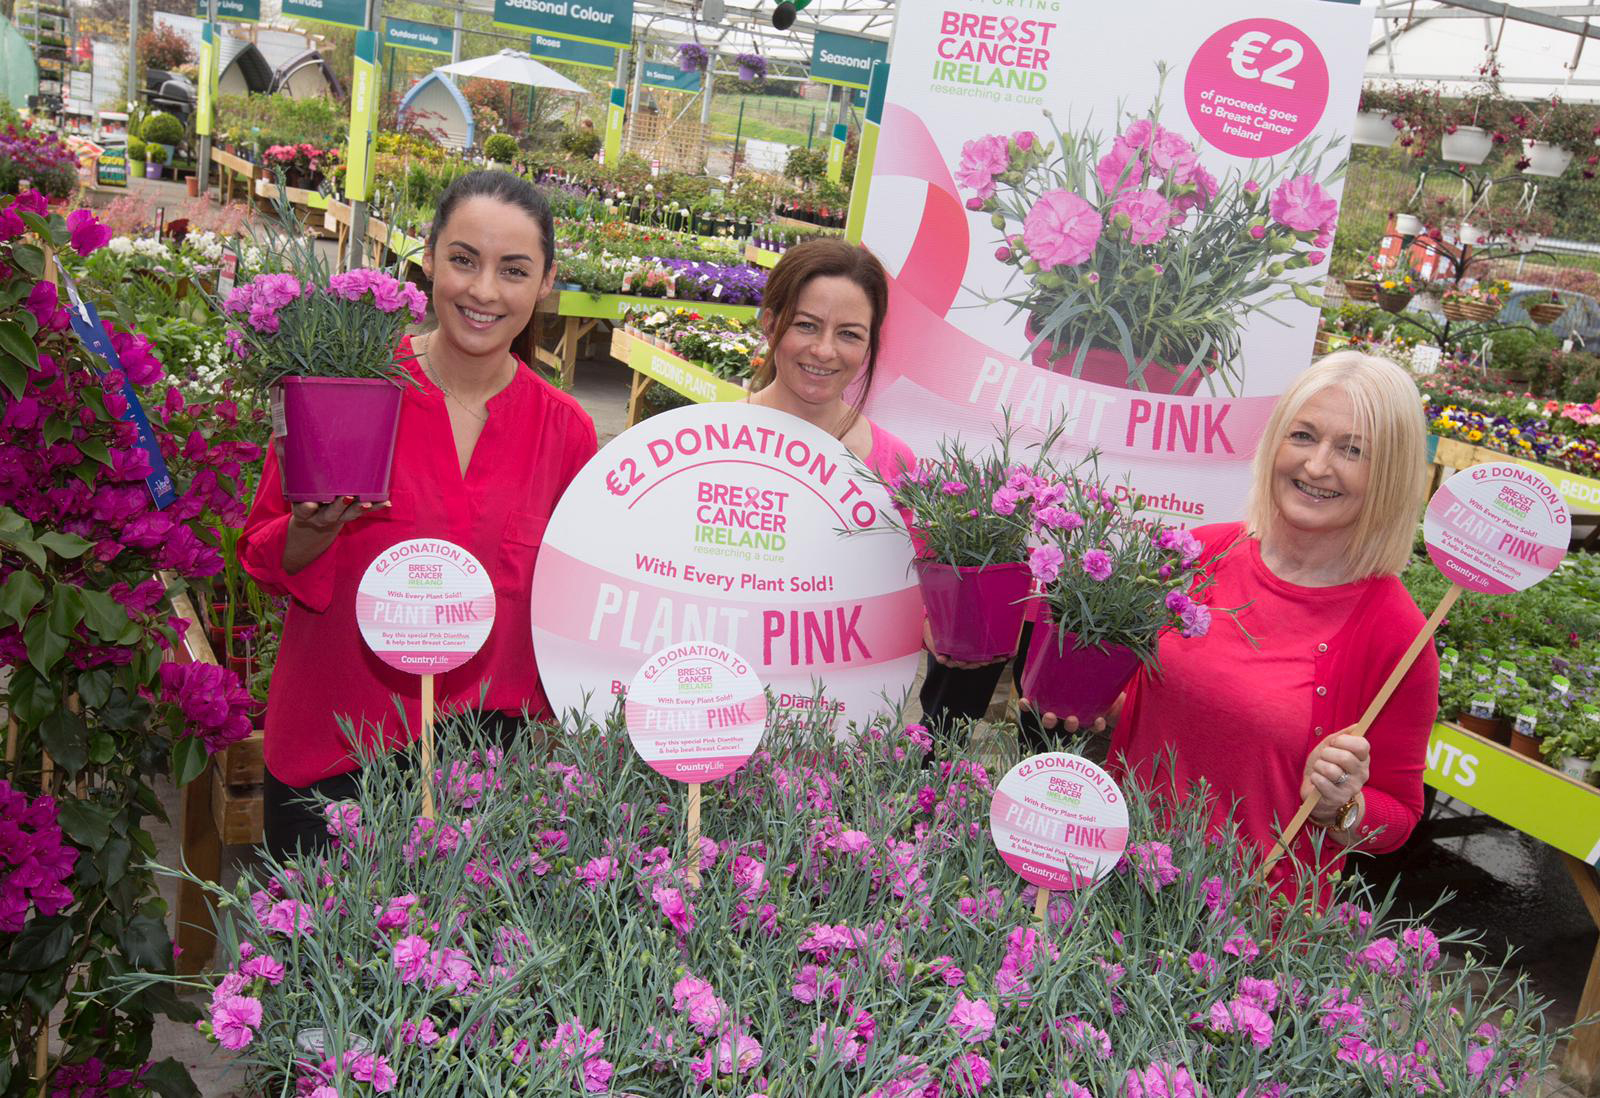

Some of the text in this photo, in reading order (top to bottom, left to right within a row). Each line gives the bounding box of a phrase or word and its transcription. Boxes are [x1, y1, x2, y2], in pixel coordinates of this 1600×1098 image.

[571, 4, 614, 24] Colour
[941, 11, 1056, 46] BREAST
[390, 28, 438, 45] Outdoor Living
[536, 36, 561, 48] Roses
[820, 49, 870, 70] Seasonal
[938, 38, 1050, 70] CANCER
[1226, 31, 1304, 90] €2
[932, 60, 1047, 92] IRELAND
[930, 84, 1043, 106] researching a cure
[1200, 90, 1298, 122] of proceeds goes
[1200, 103, 1294, 136] to Breast Cancer
[1222, 122, 1262, 142] Ireland
[93, 340, 146, 443] EXUSIVE
[969, 356, 1236, 454] PLANT PINK
[604, 423, 876, 528] €2 DONATION TO
[697, 481, 789, 512] BREAST
[1114, 484, 1204, 516] Dnthus
[1472, 467, 1567, 525] €2 DONATION TO
[1491, 498, 1527, 519] IRELAND
[1493, 493, 1531, 513] CANCER
[696, 504, 786, 533] CANCER
[1468, 498, 1483, 511] With
[1483, 508, 1501, 522] Every
[1502, 519, 1519, 530] Plant
[1520, 528, 1538, 538] Sold!
[694, 524, 786, 551] IRELAND
[1444, 502, 1501, 545] PLANT
[1498, 533, 1544, 565] PINK
[375, 544, 477, 574] €2 DONATION TO
[694, 545, 750, 560] researching
[763, 552, 784, 563] cure
[1442, 531, 1522, 577] Buy this special Pink Dianthus
[1447, 542, 1460, 554] help
[1460, 548, 1473, 559] beat
[1473, 553, 1492, 570] Breast
[1492, 565, 1515, 580] Cancer!
[634, 553, 834, 592] With Every Plant Sold!
[1446, 559, 1489, 587] CountryLife
[387, 590, 462, 600] With Every Plant Sold!
[373, 601, 479, 624] PLANT PINK
[589, 582, 872, 666] PLANT PINK
[408, 632, 428, 640] special
[401, 655, 448, 666] CountryLife
[644, 646, 747, 680] €2 DONATION TO
[610, 680, 630, 695] Bu
[676, 697, 695, 705] Every
[697, 696, 714, 704] Plant
[716, 694, 733, 703] Sold!
[644, 709, 702, 731] PLANT
[707, 703, 751, 729] PINK
[780, 694, 846, 712] Dianhs
[676, 761, 724, 772] CountryLife
[1426, 740, 1479, 787] NTS
[1019, 758, 1117, 803] €2 DONATION TO
[1048, 784, 1082, 799] CANCER
[1024, 796, 1039, 808] With
[1041, 802, 1060, 815] Every
[1060, 809, 1078, 820] Plant
[1079, 814, 1097, 823] Sold!
[1005, 803, 1107, 849] PLANT PINK
[1009, 834, 1094, 864] Buy this special Pink Dianthus
[1017, 845, 1031, 854] help
[1032, 849, 1045, 858] beat
[1046, 853, 1064, 863] Breast
[1022, 863, 1068, 882] CountryLife
